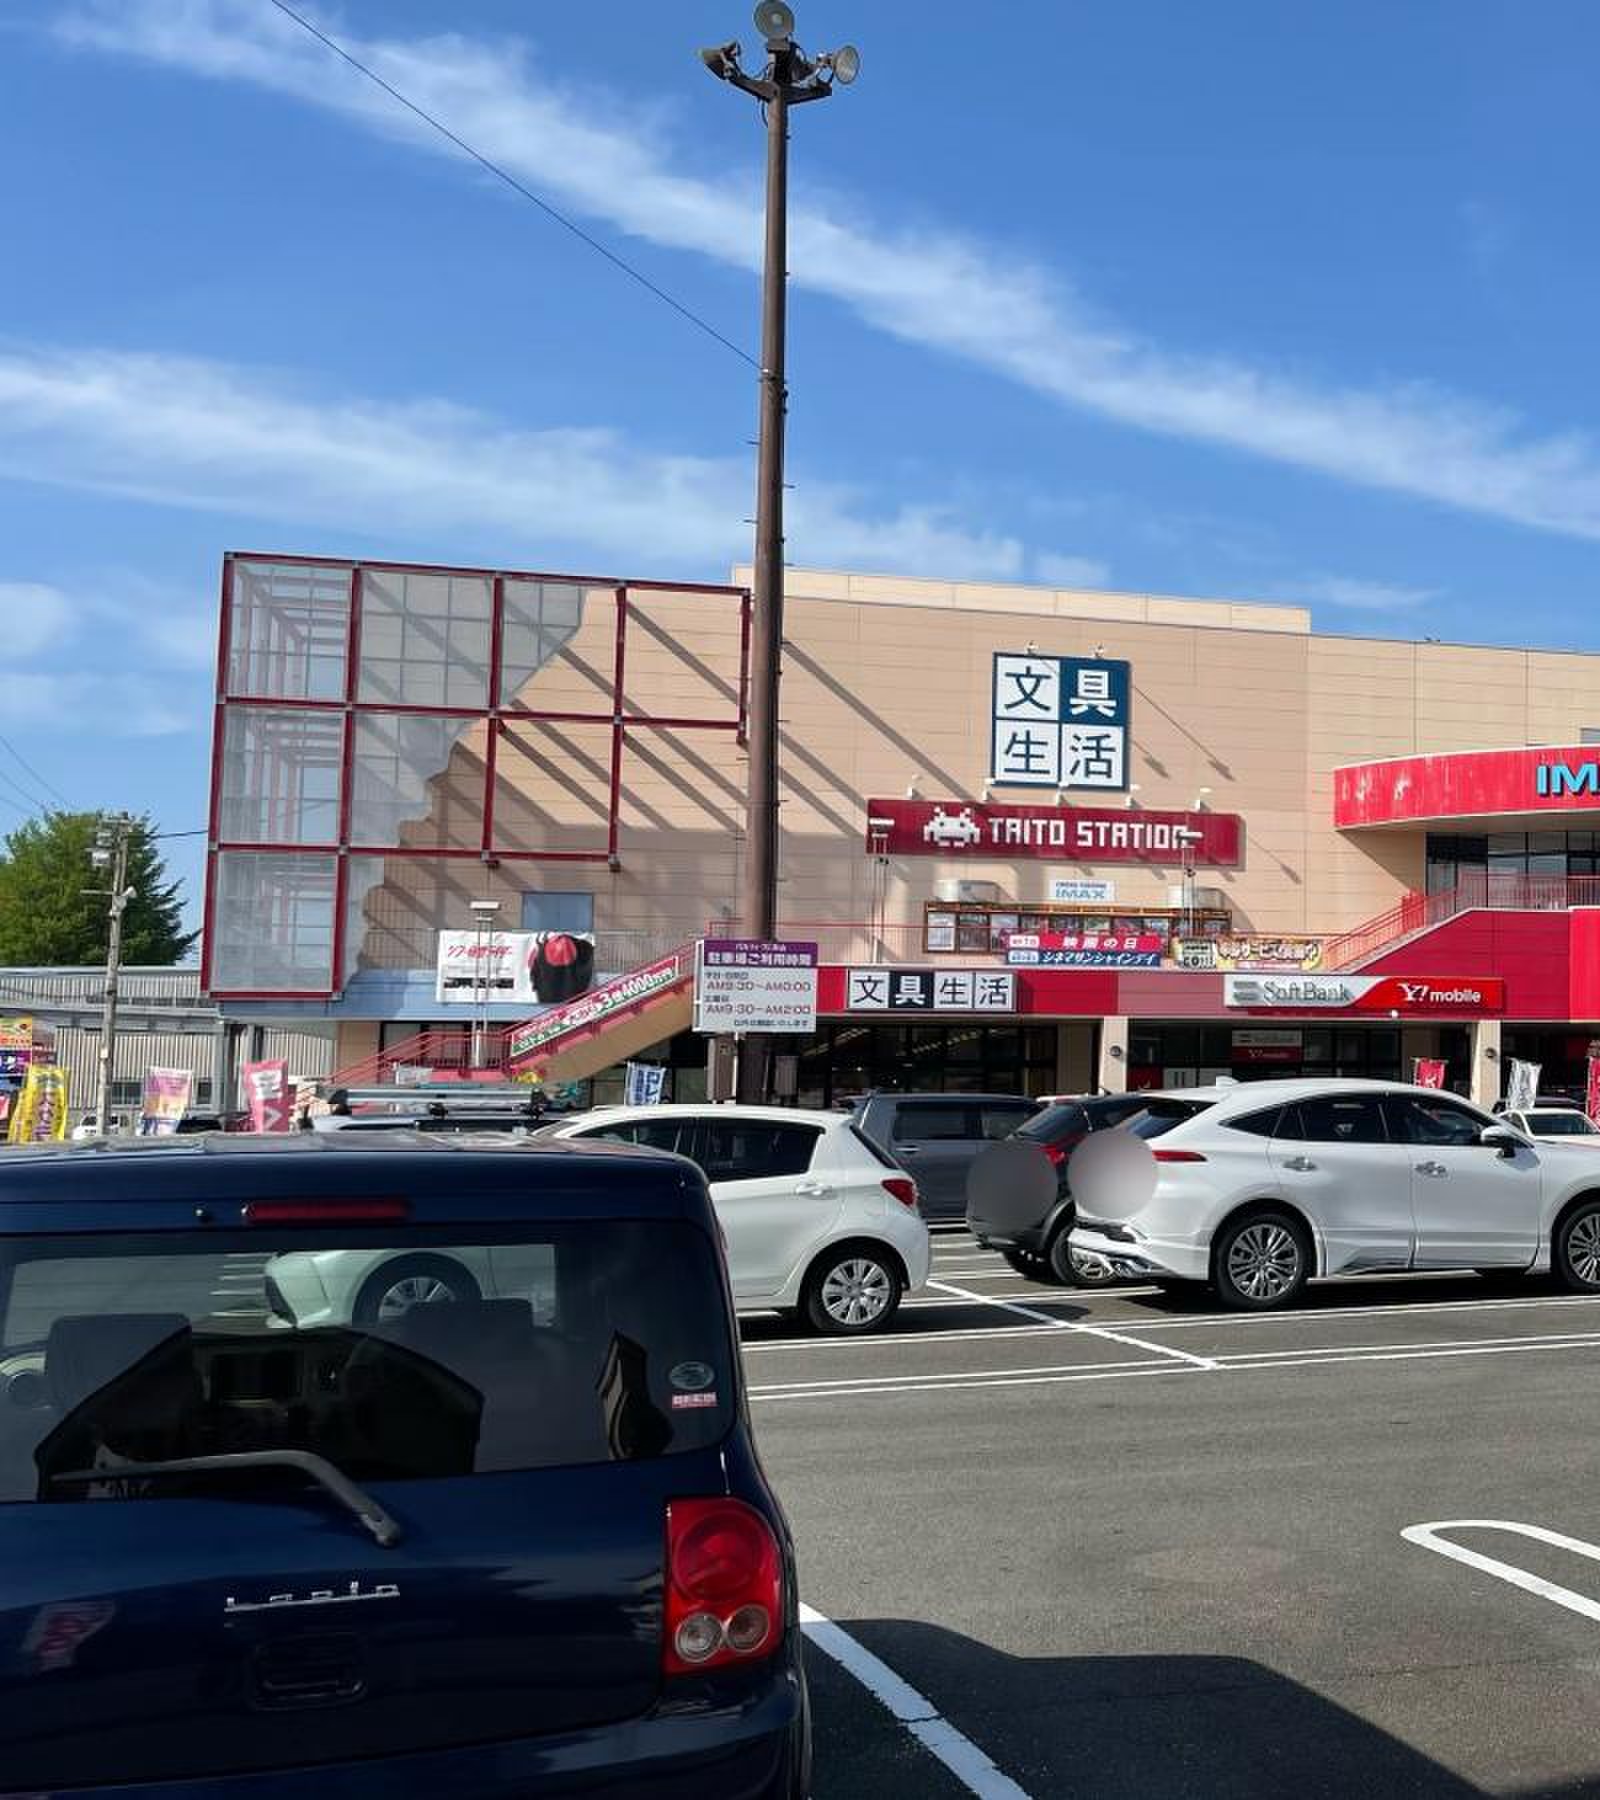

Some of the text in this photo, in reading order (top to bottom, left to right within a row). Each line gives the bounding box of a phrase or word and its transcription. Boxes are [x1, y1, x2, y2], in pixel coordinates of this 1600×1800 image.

[1004, 666, 1117, 717] 文具
[1003, 730, 1117, 779] 生活
[988, 818, 1066, 845] TAITO
[854, 975, 1009, 1005] 文具生活
[1263, 981, 1351, 1002] SoftBank
